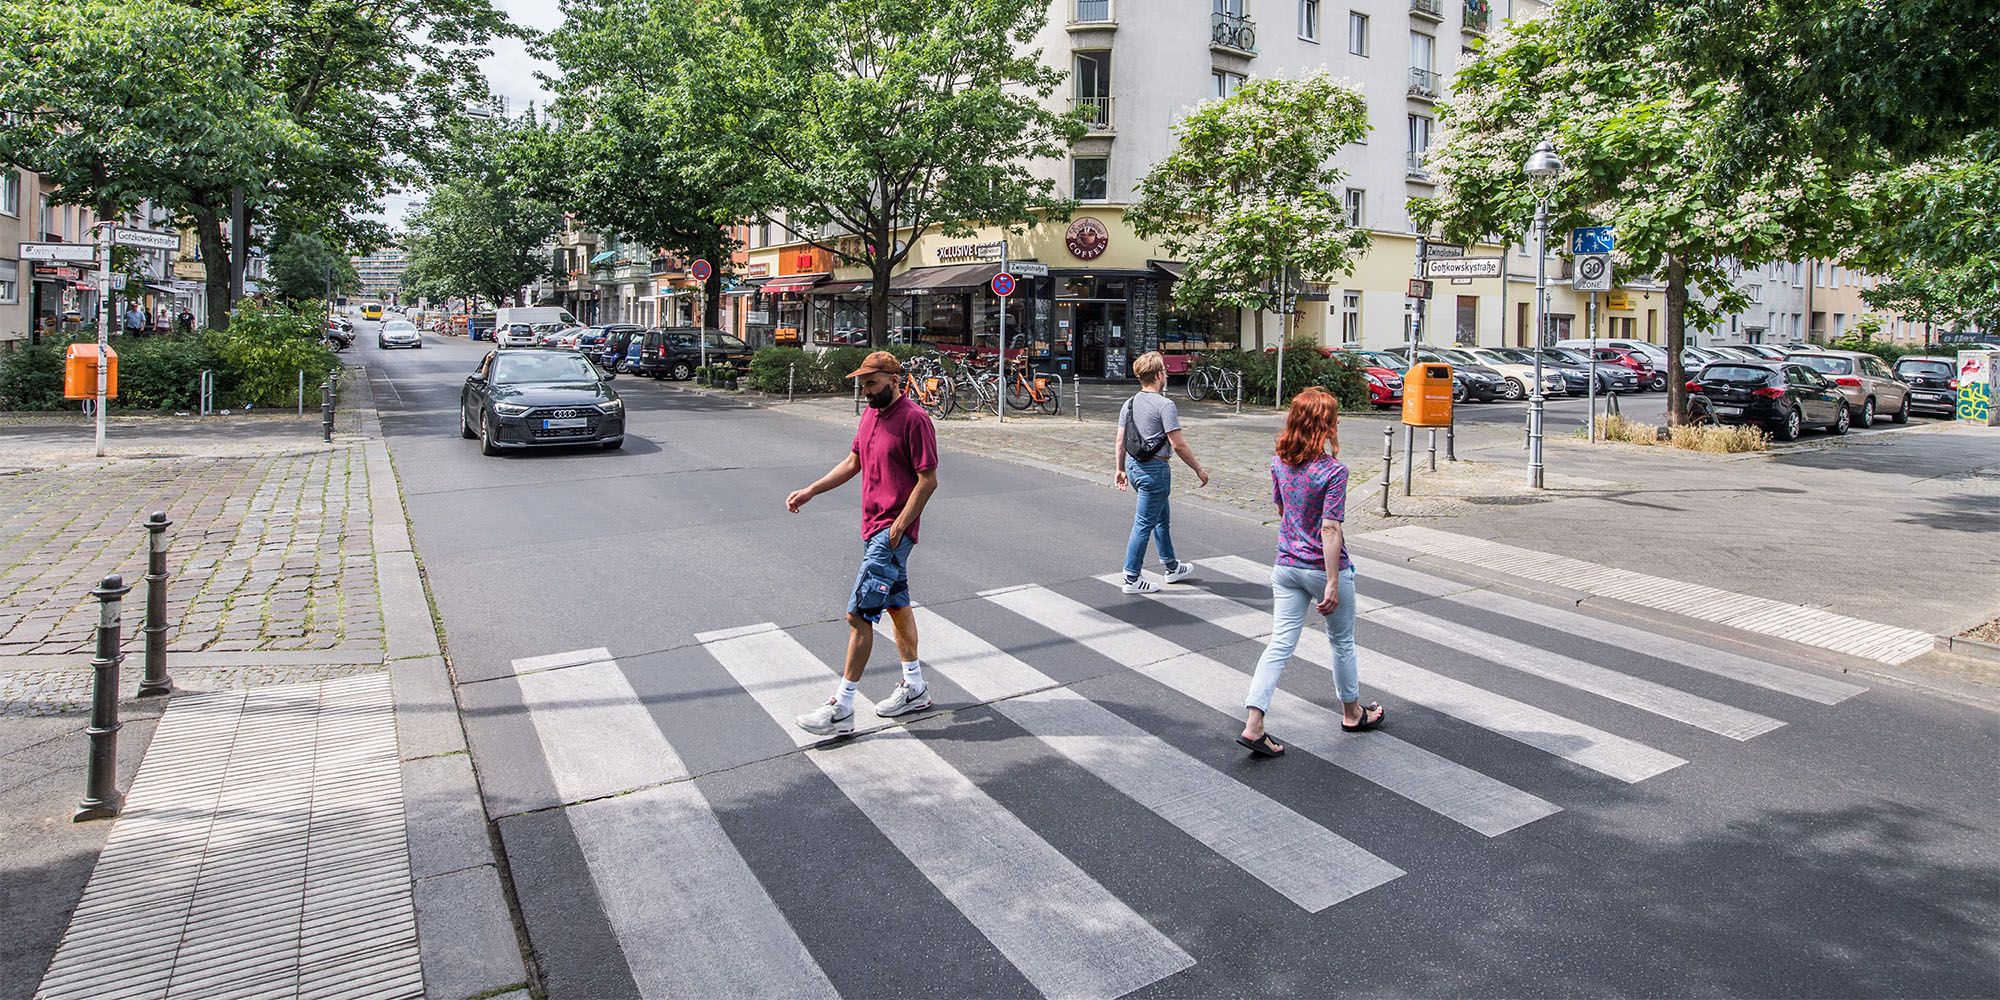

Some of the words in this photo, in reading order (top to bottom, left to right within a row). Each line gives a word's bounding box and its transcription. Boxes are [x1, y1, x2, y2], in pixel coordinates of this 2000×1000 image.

[118, 231, 176, 246] Gotzkowskystraße
[937, 244, 975, 258] EXCLUSIVE
[1428, 246, 1461, 257] Zwinglistraße
[1011, 263, 1045, 274] Zwinglistraße
[1431, 261, 1496, 274] Gotzkowskystraße
[1585, 262, 1600, 274] 30
